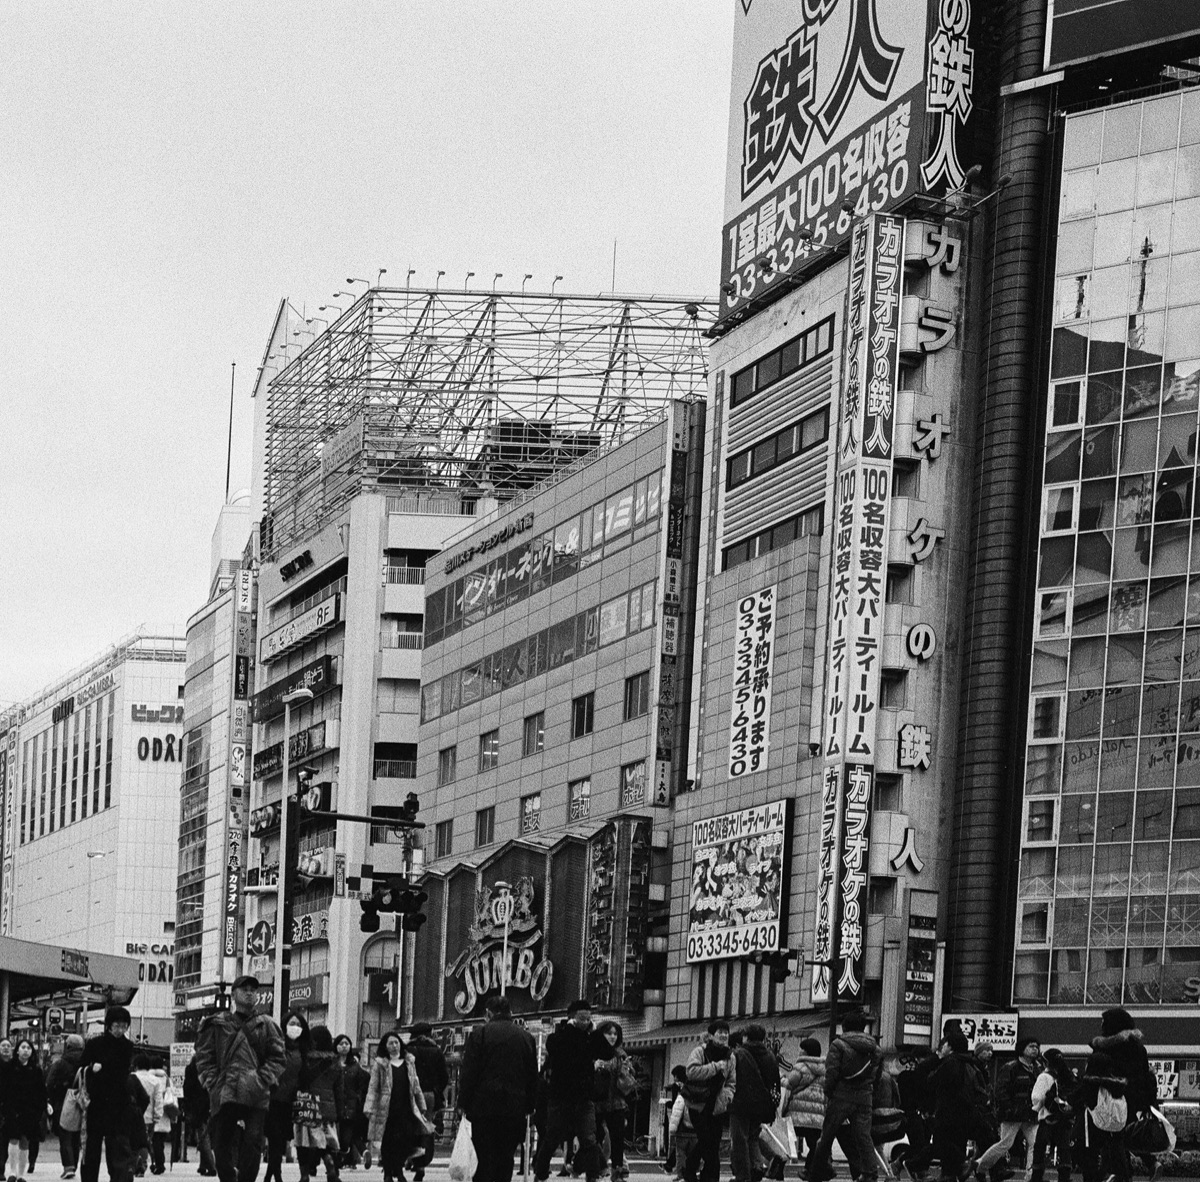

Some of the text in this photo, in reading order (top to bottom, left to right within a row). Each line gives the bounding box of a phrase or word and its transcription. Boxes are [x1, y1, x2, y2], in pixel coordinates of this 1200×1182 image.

[864, 216, 904, 457] カラオケの鉄人
[848, 466, 889, 757] 100名収容大パーティールーム
[894, 224, 962, 873] カラオケの鉄人
[730, 596, 756, 777] 03-3345-6430
[749, 588, 773, 772] ご予約承ります
[227, 874, 239, 912] カラオケ
[694, 803, 784, 847] 100名収容大パーティールーム
[836, 763, 873, 996] カラオケの鉄人
[454, 949, 554, 1015] JUMBO
[977, 1018, 1016, 1037] 赤から
